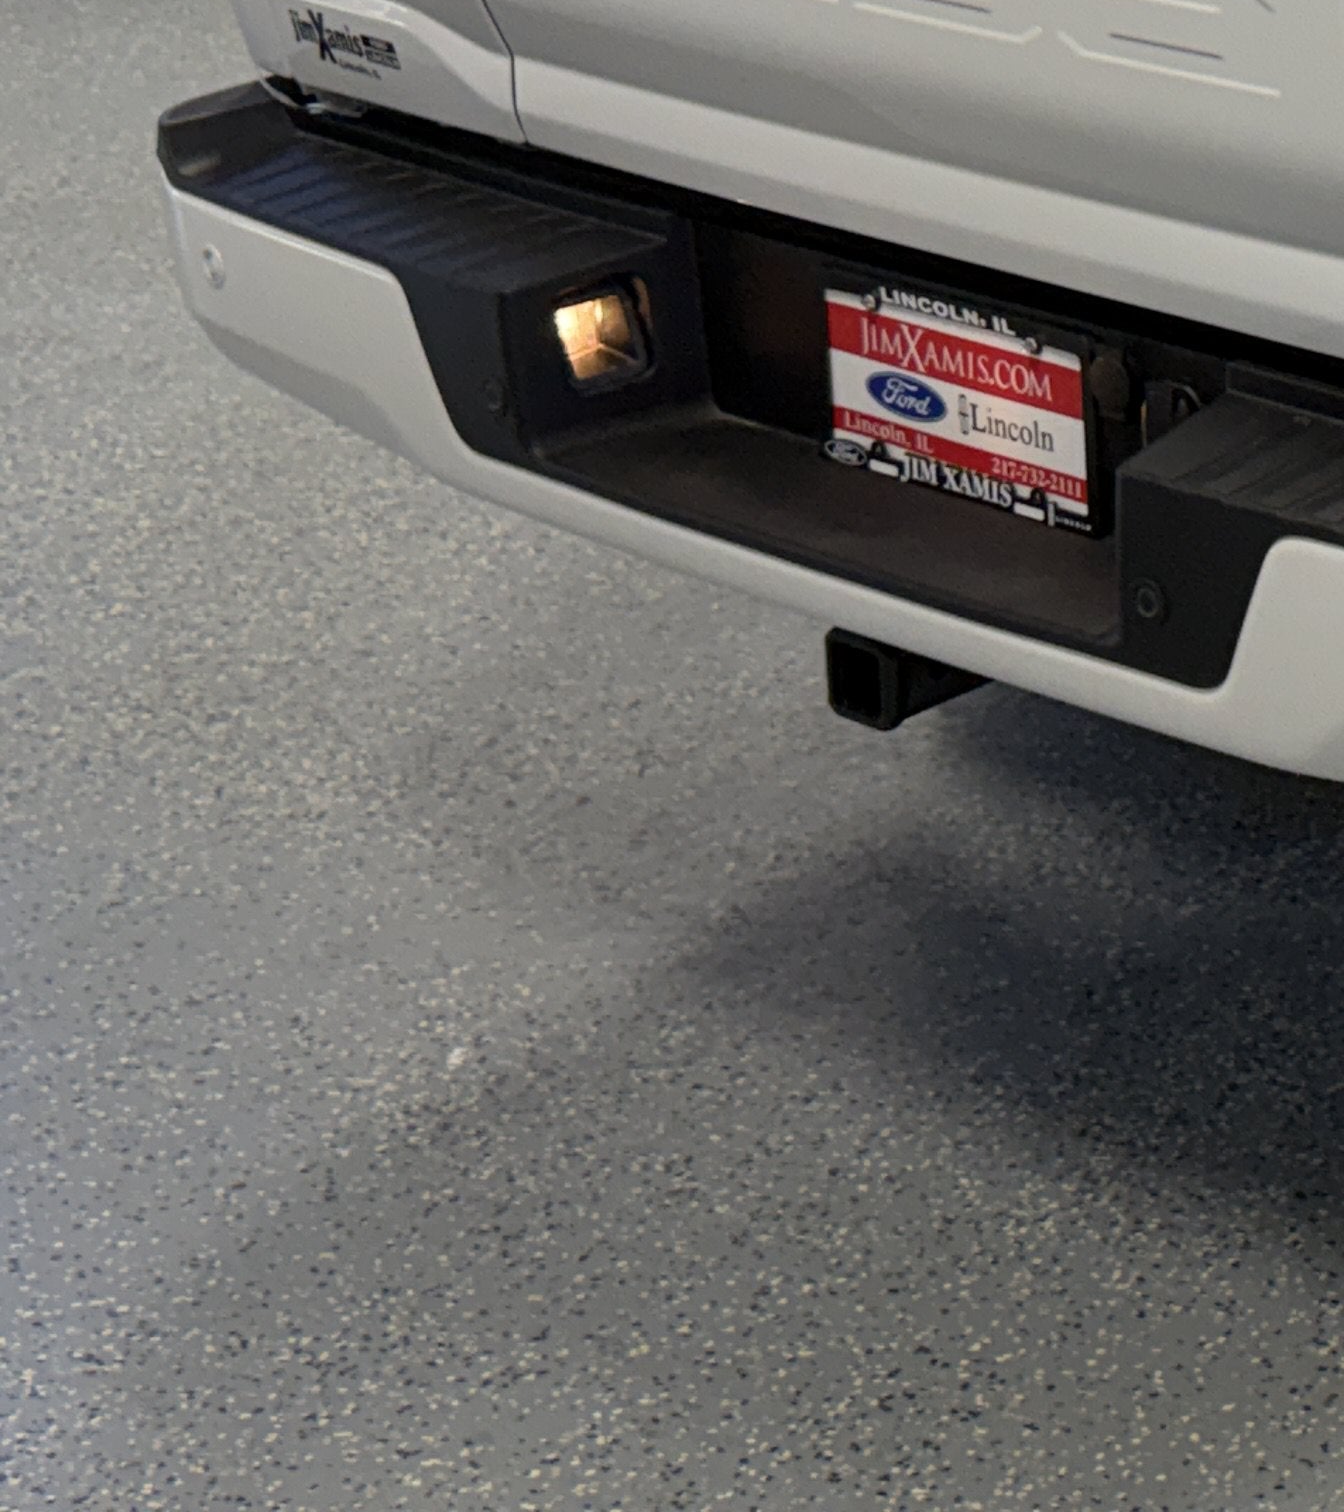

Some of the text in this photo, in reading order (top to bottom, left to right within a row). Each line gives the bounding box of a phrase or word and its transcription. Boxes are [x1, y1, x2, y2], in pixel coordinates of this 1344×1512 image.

[881, 377, 932, 416] Ford
[970, 402, 1055, 452] Lincoln
[900, 452, 1015, 508] JIM XAMIS
